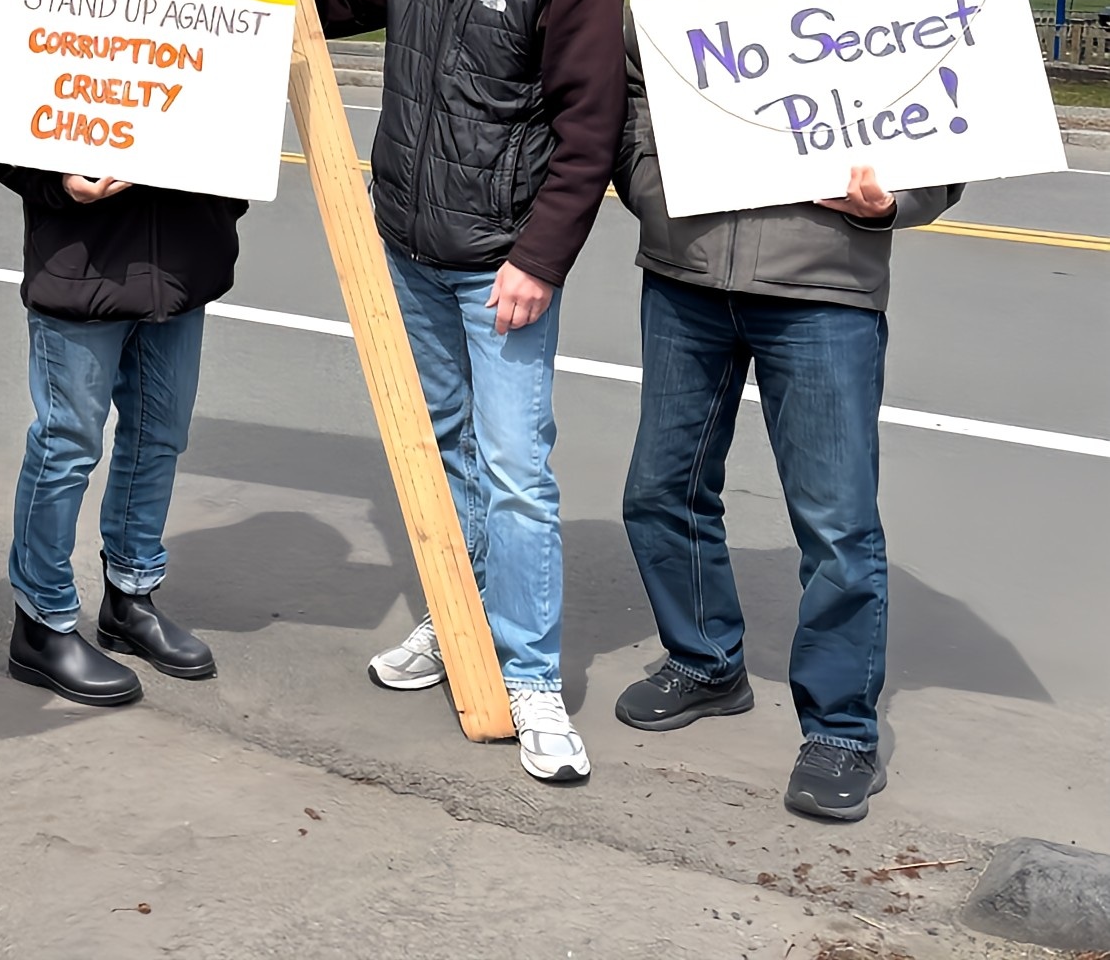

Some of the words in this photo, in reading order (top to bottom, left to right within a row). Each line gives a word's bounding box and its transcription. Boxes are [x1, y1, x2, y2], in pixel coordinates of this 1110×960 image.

[160, 1, 271, 36] AGAINST
[28, 27, 204, 71] CORRUPTION
[686, 21, 769, 90] No
[54, 73, 183, 112] CRUELTY
[755, 66, 968, 155] Police!
[30, 105, 135, 149] CHAOS
